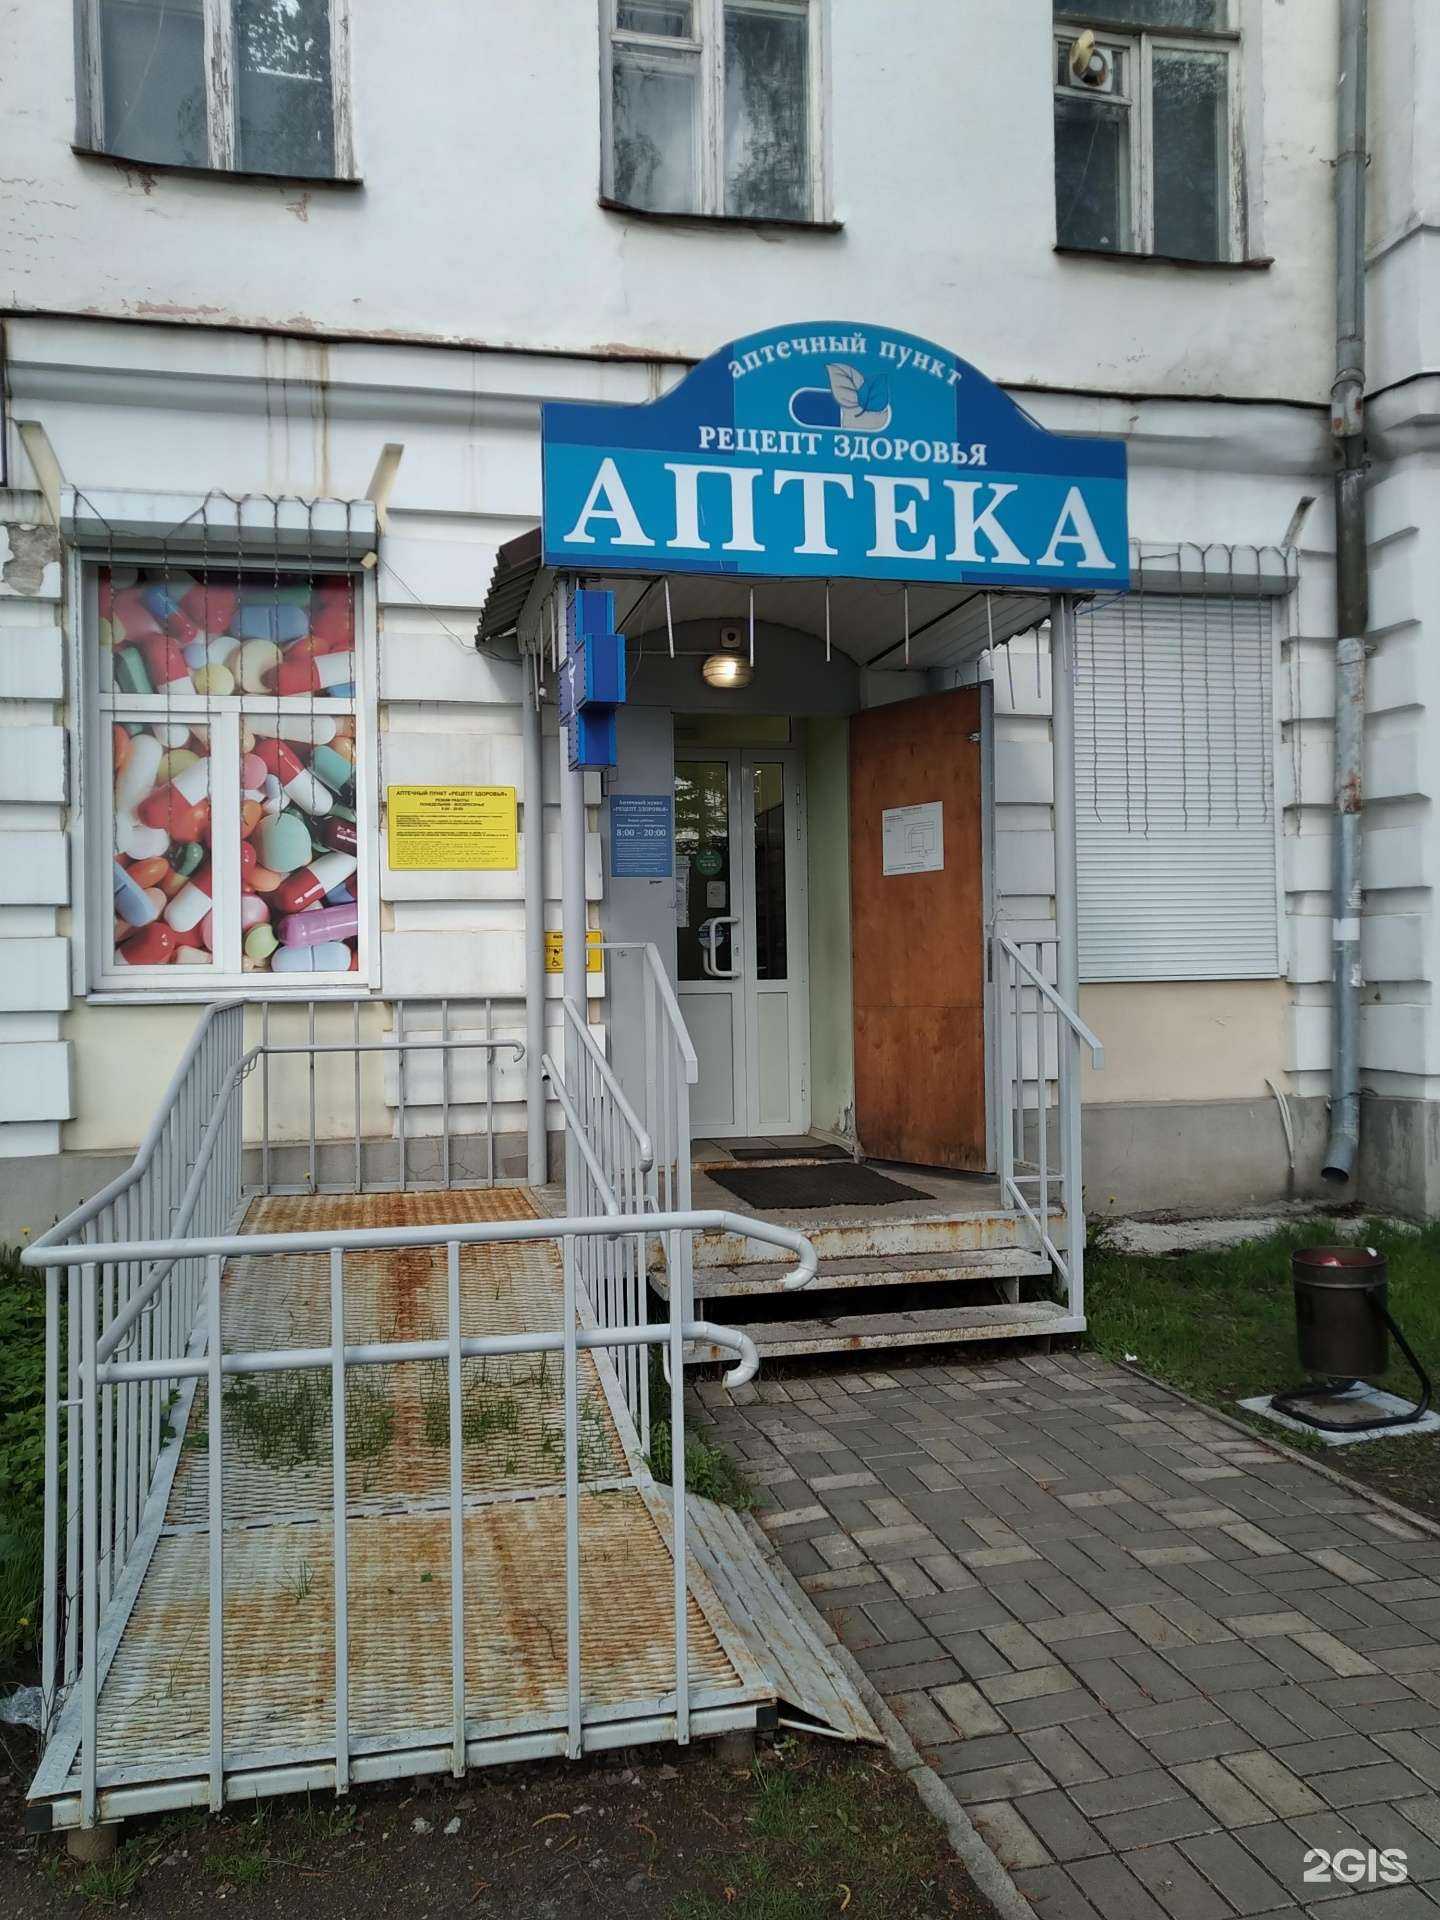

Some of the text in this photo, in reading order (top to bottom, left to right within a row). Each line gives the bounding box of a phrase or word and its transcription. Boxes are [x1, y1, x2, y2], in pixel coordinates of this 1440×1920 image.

[727, 331, 963, 387] аптечный пункт
[698, 426, 988, 467] РЕЦЕПТ ЗДОРОВЬЯ
[562, 457, 1117, 570] АПТЕКА
[643, 829, 666, 837] 20:00
